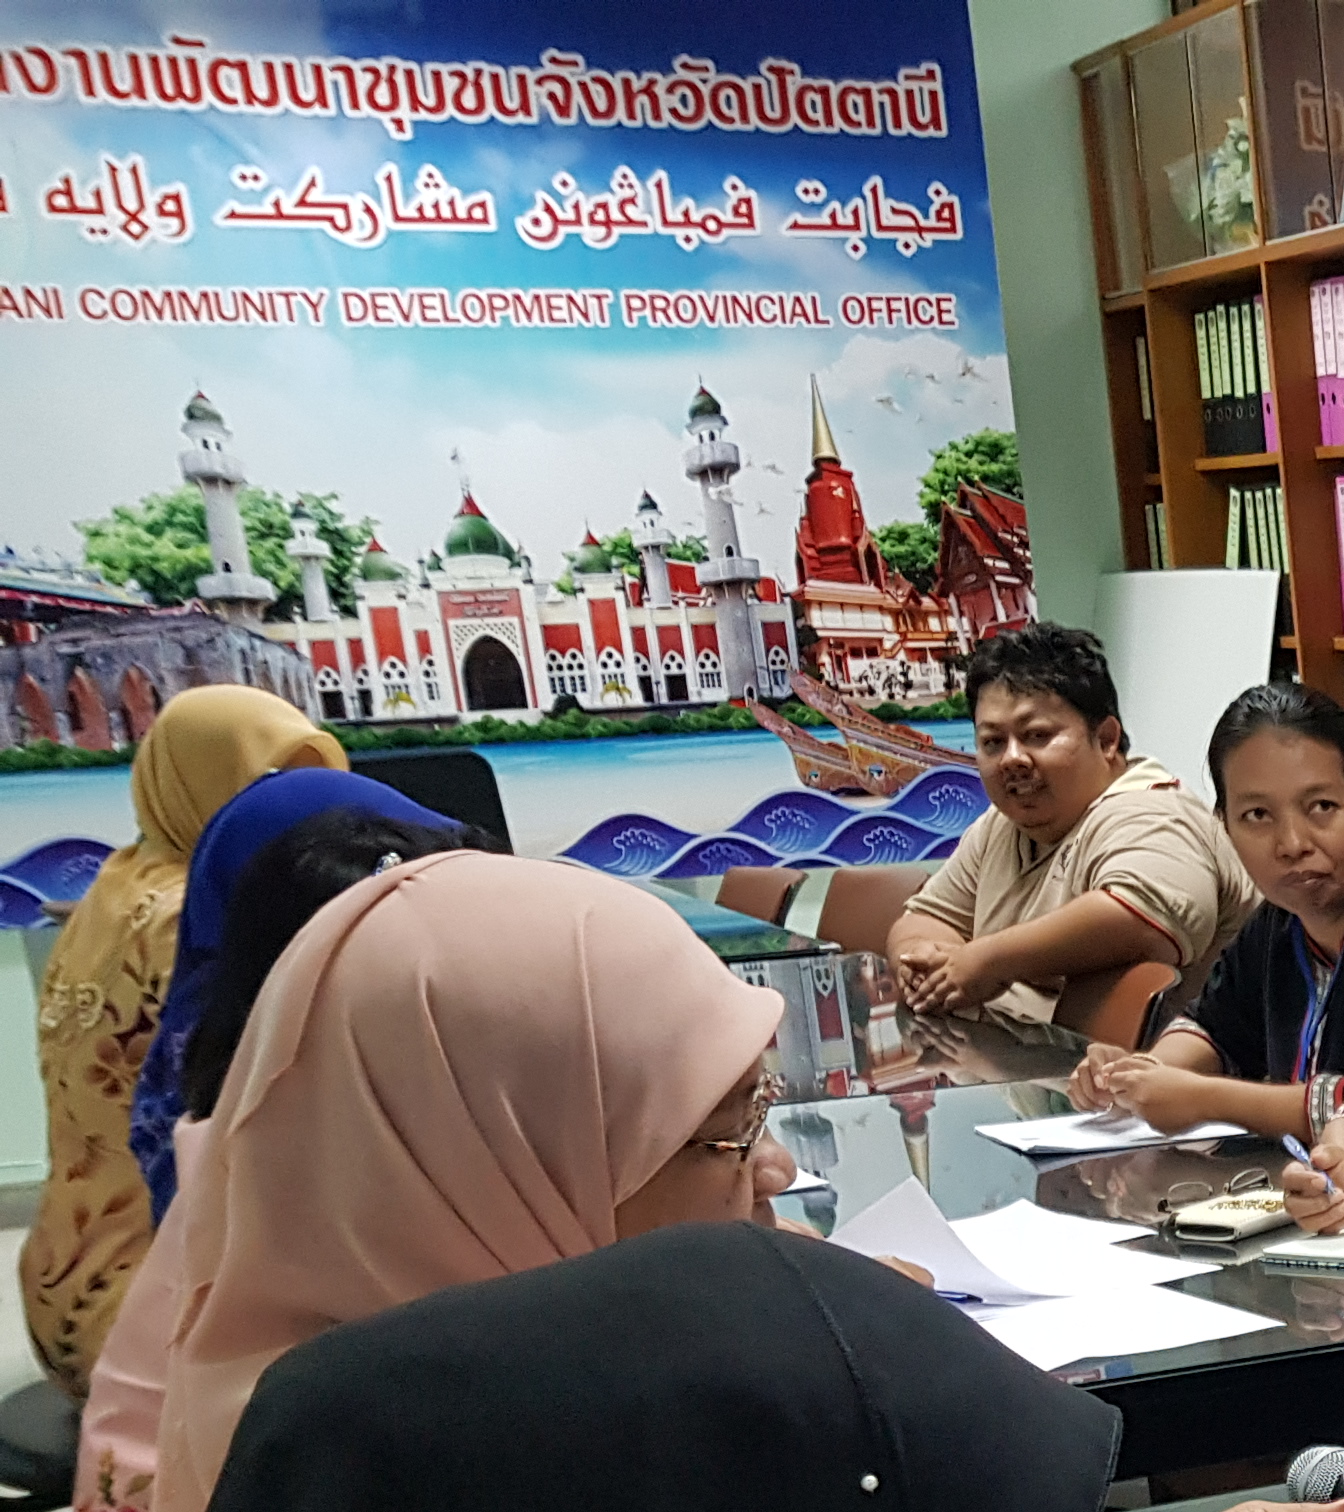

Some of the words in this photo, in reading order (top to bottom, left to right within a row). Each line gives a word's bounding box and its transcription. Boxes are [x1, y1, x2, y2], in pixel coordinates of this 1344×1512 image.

[0, 34, 945, 134] งานพัฒนาชุมชนจังหวัดปัตตานี
[80, 287, 326, 323] COMMUNITY
[343, 290, 609, 324] DEVELOPMENT
[625, 294, 830, 326] PROVINCIAL
[842, 296, 956, 326] OFFICE
